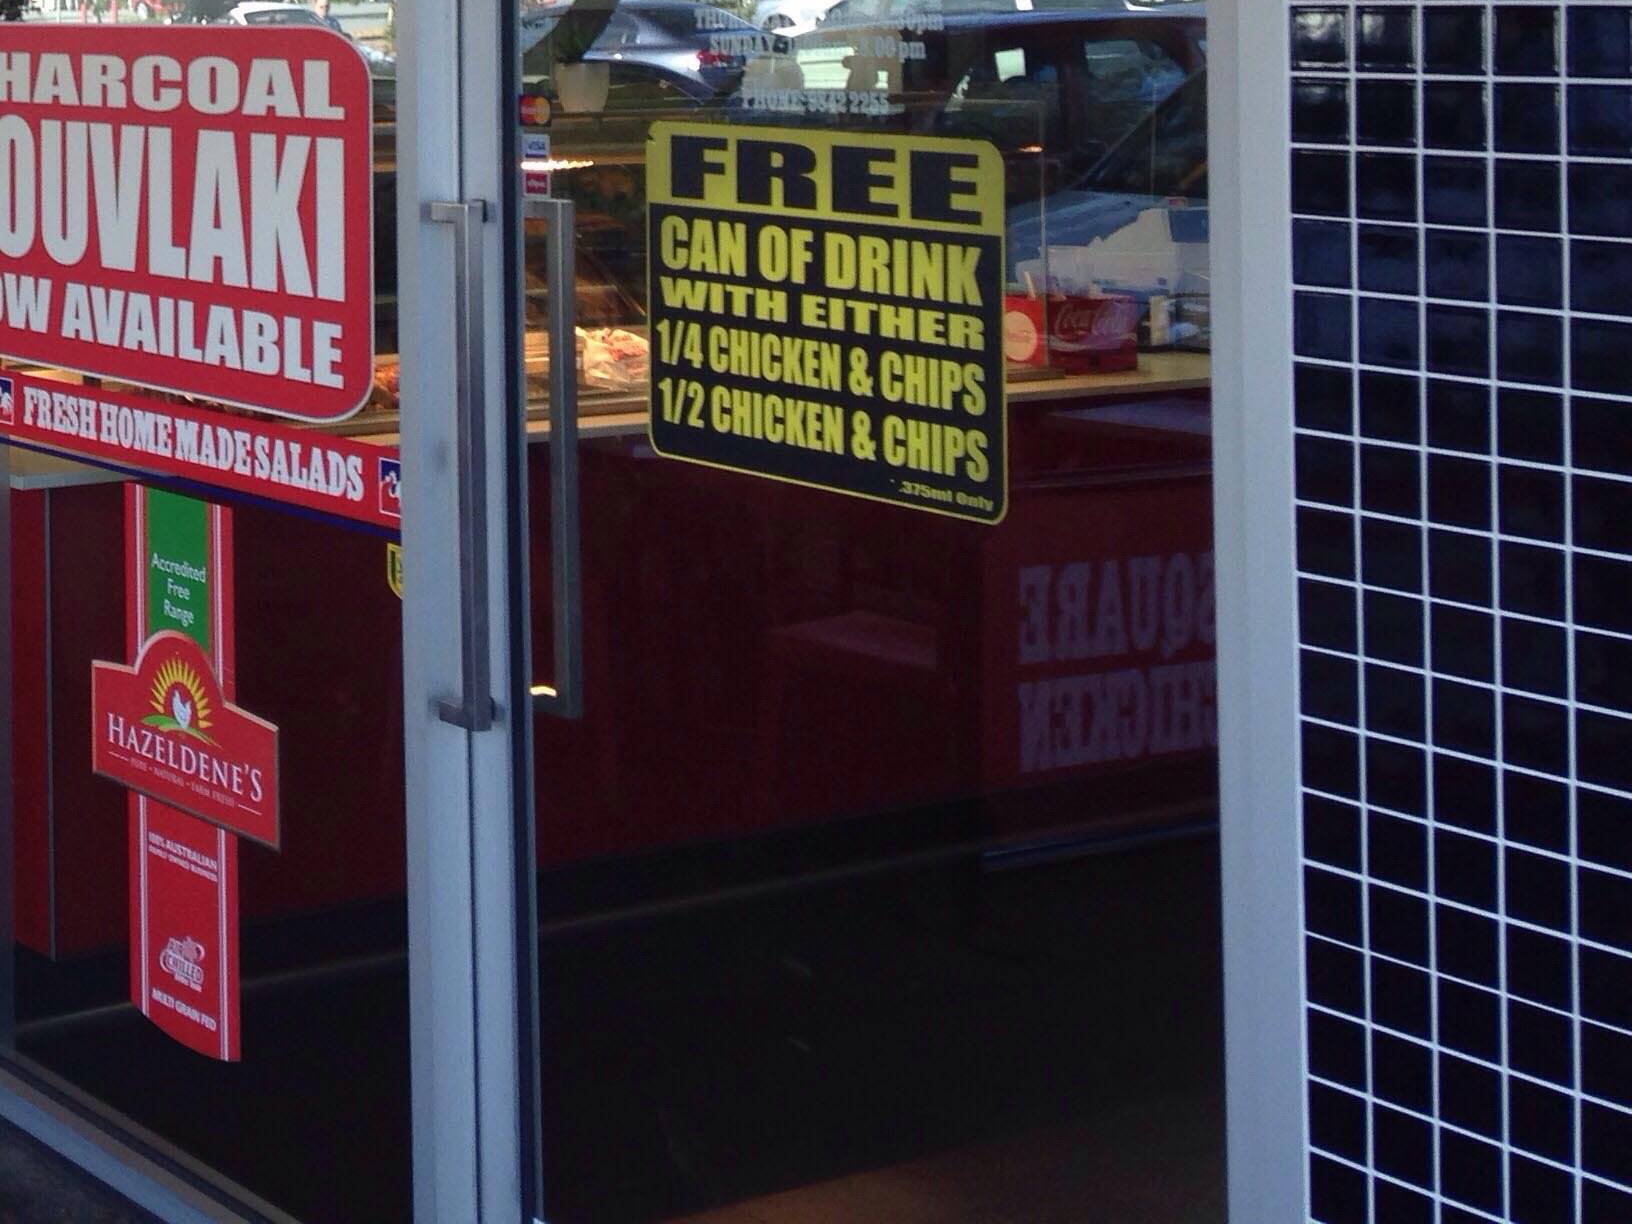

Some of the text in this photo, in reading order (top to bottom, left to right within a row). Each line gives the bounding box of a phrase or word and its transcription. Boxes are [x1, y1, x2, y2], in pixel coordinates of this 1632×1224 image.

[671, 134, 983, 226] FREE
[660, 215, 984, 307] CAN OF DRINK
[61, 282, 345, 390] AVAILABLE
[661, 276, 985, 351] WITH EITHER
[657, 318, 987, 417] 1/4 CHICKEN & CHIPS
[22, 386, 365, 503] FRESH HOME MADE SALADS
[658, 377, 990, 483] 1/2 CHICKEN & CHIPS
[151, 552, 206, 584] Accredited
[164, 598, 195, 628] Range
[167, 577, 191, 601] Free
[106, 712, 264, 803] HAZELDENE'S
[166, 838, 218, 873] AUSTRALIAN
